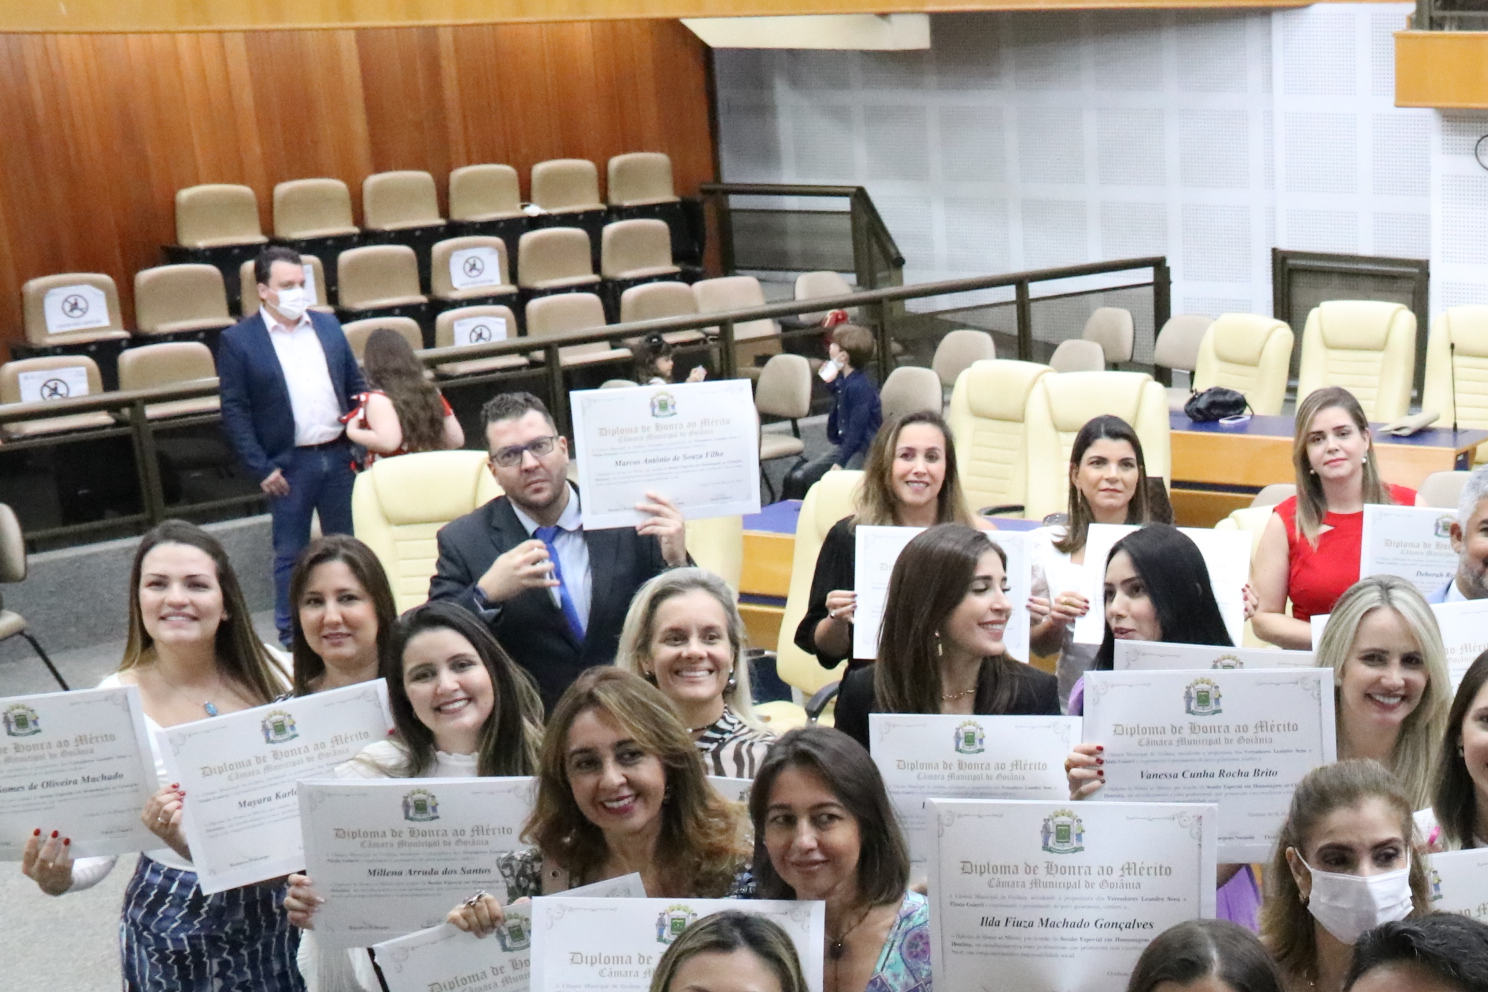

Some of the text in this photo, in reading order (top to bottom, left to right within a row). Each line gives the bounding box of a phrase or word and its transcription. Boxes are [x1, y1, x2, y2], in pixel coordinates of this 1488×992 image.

[615, 459, 641, 467] Marcos
[643, 456, 670, 464] Antônio
[705, 451, 724, 459] Filho
[1384, 539, 1420, 549] Diploma
[1113, 720, 1298, 737] Diploma de Honra ao Mérito
[56, 739, 70, 748] ao
[75, 732, 116, 747] Mérito
[29, 772, 123, 790] de Oliveira Machado
[1140, 768, 1277, 779] Vanessa Cunha Rocha Brito
[238, 796, 272, 809] Mayara
[368, 868, 403, 877] Millena
[407, 868, 439, 876] Arruda
[460, 867, 491, 875] Santos
[960, 860, 1172, 878] Diploma de Honra ao Mérito
[980, 916, 1154, 931] Ilda Fiuza Machado Gonçalves
[569, 951, 653, 966] Diploma de
